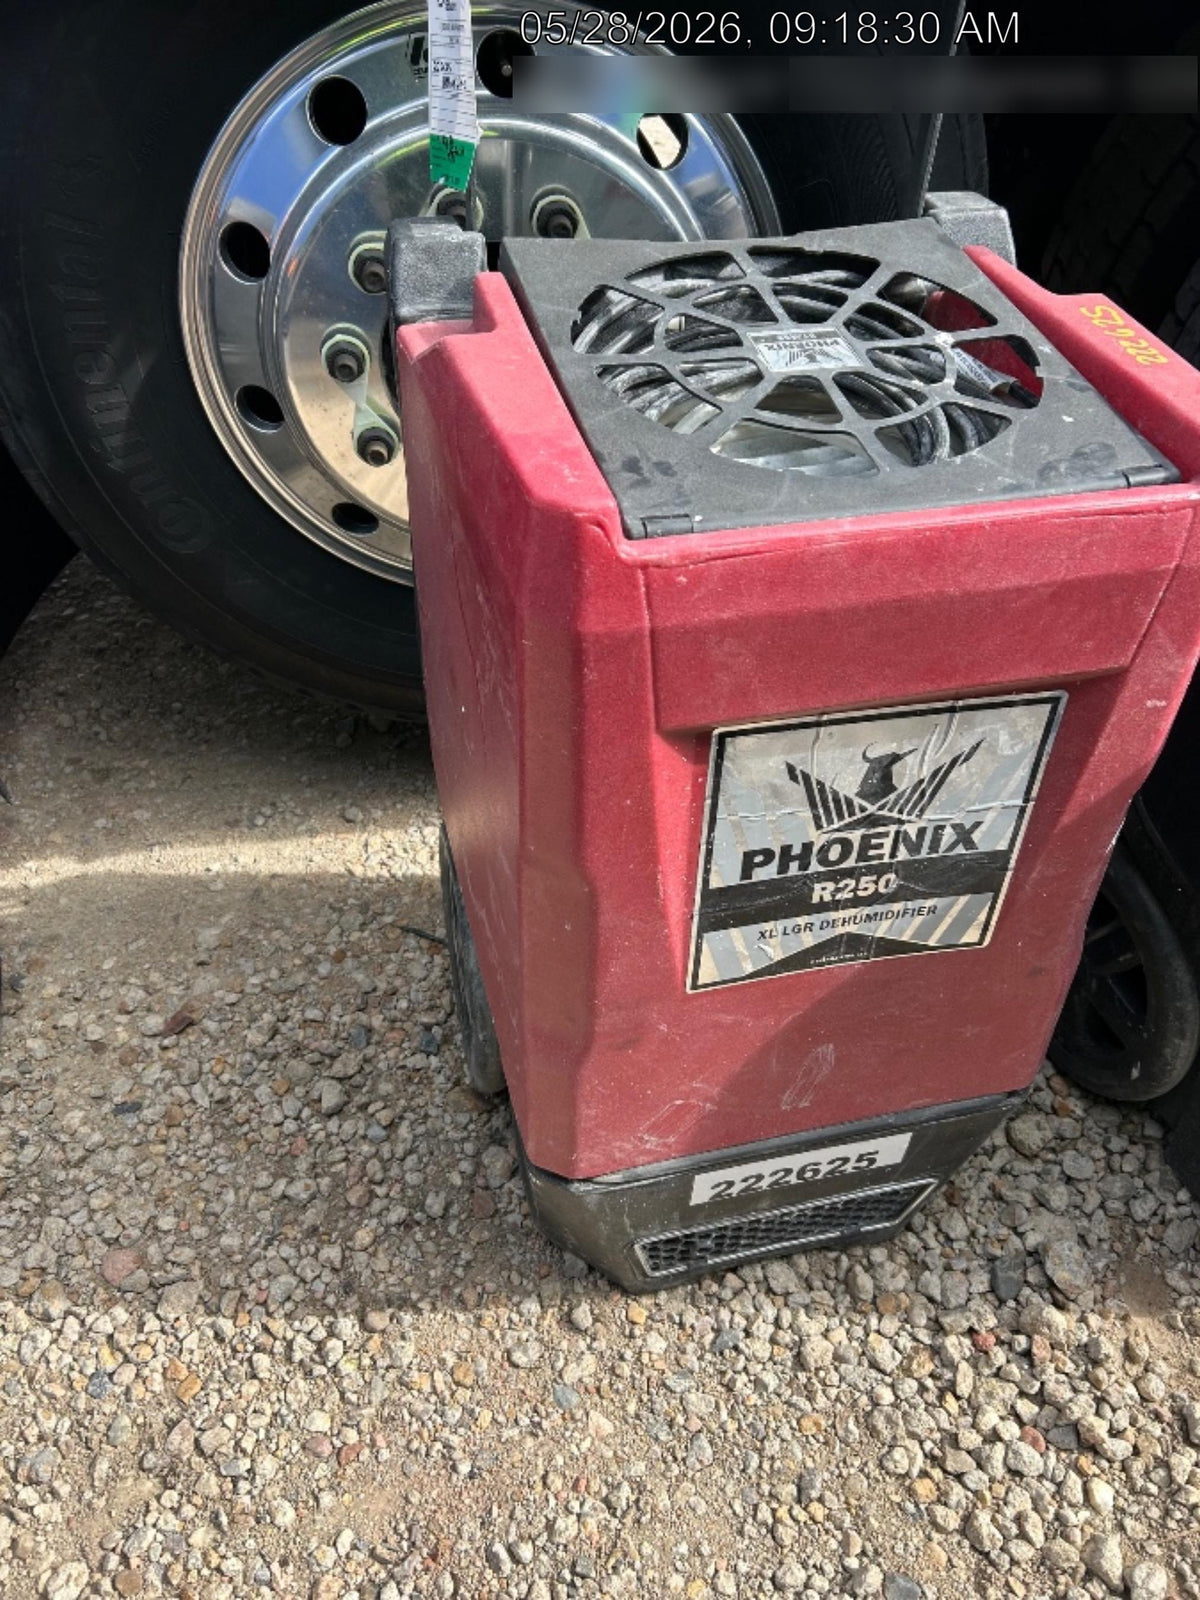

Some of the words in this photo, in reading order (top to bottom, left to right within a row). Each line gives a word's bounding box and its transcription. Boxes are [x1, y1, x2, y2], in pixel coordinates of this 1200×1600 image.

[1080, 305, 1168, 366] 222625
[740, 820, 984, 880] PHOENIX
[811, 872, 898, 904] R250
[757, 928, 777, 941] XL
[782, 921, 815, 938] LGR
[819, 904, 938, 932] DEHUMIDIFIER
[709, 1151, 880, 1201] 222625
